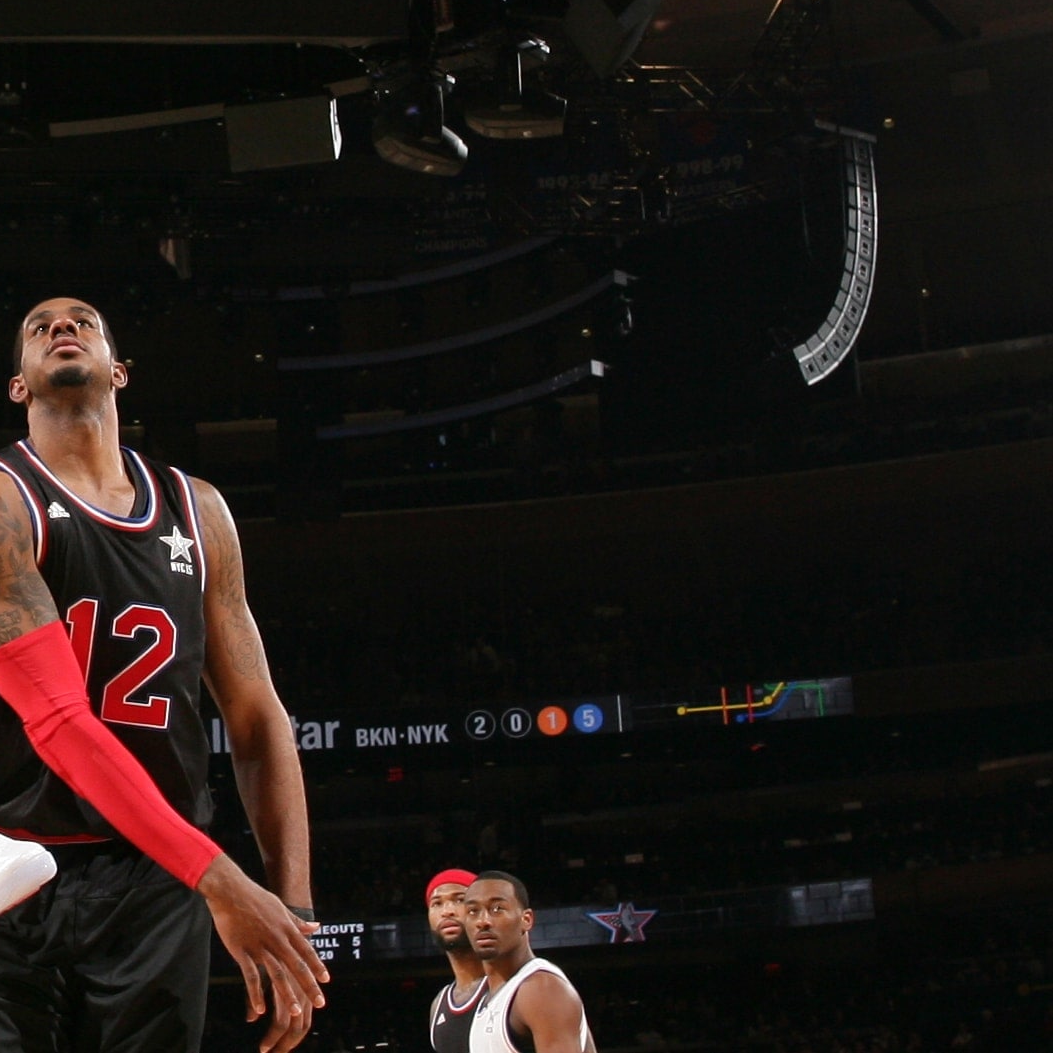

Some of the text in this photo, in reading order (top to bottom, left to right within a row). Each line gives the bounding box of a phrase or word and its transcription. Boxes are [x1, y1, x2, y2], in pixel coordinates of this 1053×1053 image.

[170, 561, 186, 573] NYC
[66, 598, 177, 729] 12
[290, 715, 341, 751] tar
[474, 716, 487, 734] 2
[510, 713, 522, 732] 0
[583, 709, 595, 727] 5
[352, 936, 361, 947] 5
[353, 949, 360, 960] 1
